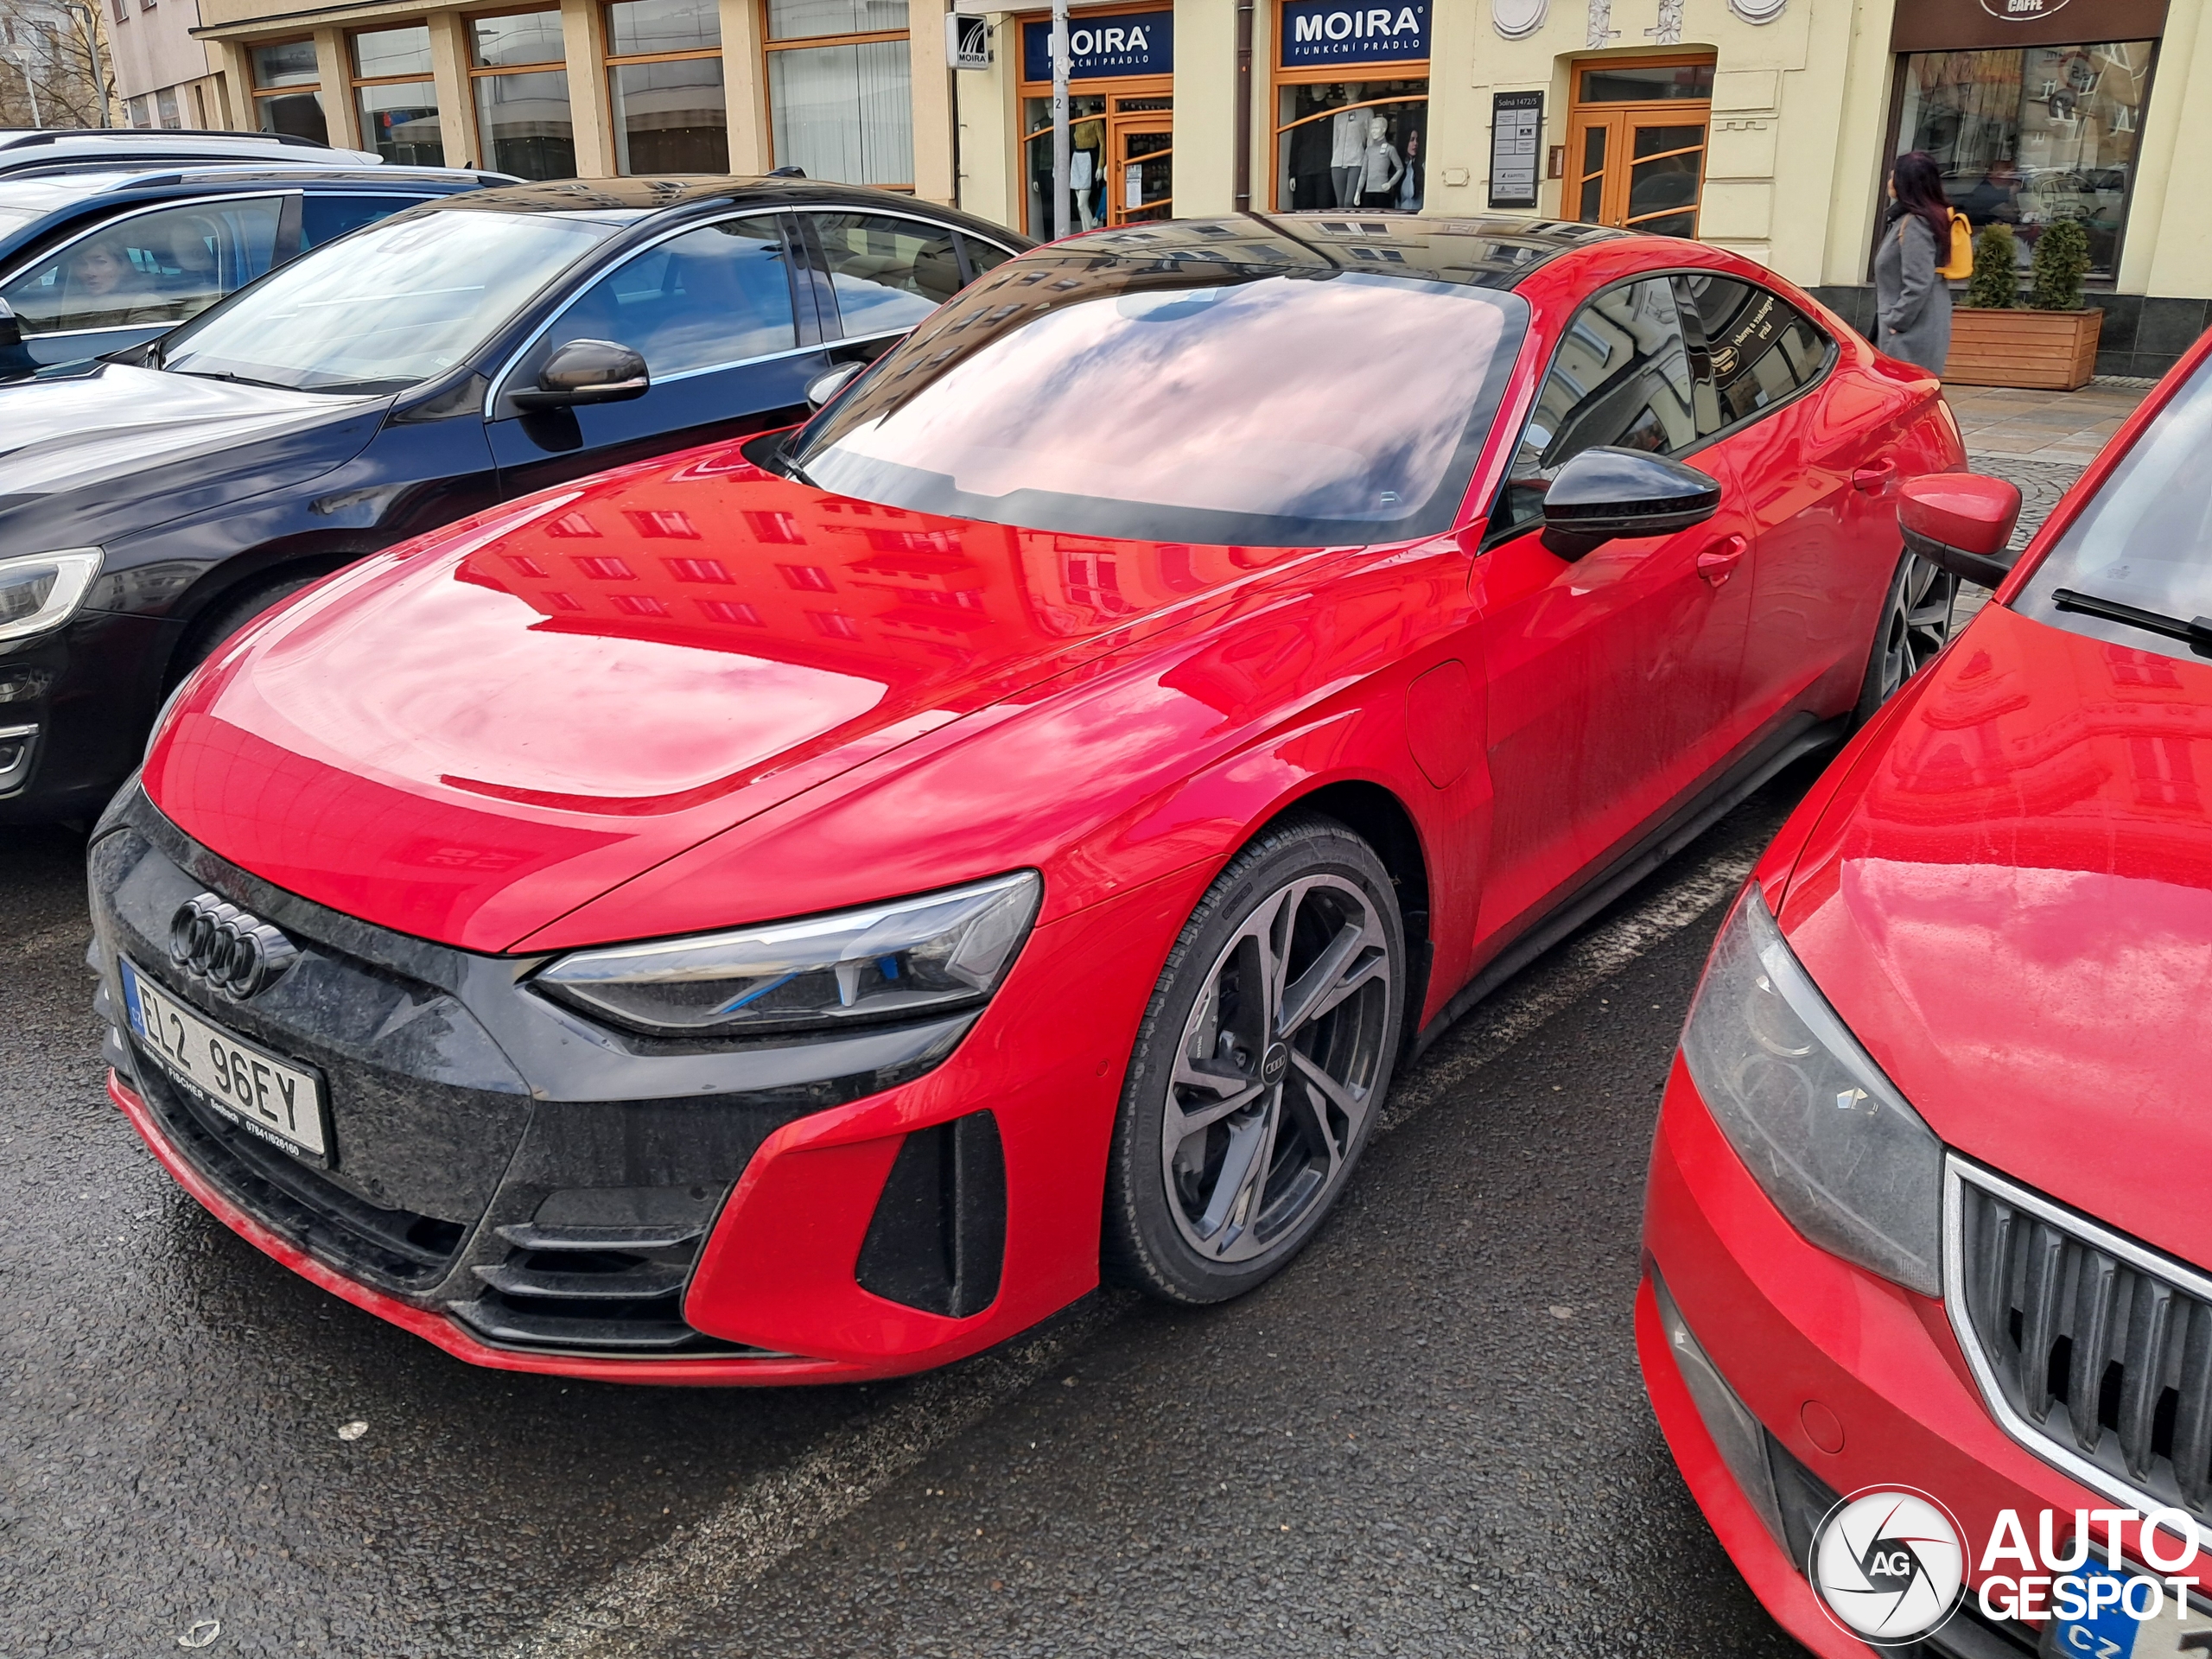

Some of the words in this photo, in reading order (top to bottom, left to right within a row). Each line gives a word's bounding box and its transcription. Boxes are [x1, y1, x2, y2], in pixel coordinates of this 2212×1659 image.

[1047, 26, 1148, 57] OIRA
[1295, 41, 1357, 56] FUNKČNÍ
[1363, 39, 1420, 51] PRÁDLO
[959, 54, 986, 62] MOIRA
[1103, 54, 1149, 66] PRÁDLO
[1055, 98, 1062, 110] 2
[1498, 99, 1516, 107] Solná
[139, 984, 192, 1071] EL2
[209, 1038, 296, 1132] 96EY
[168, 1067, 205, 1101] FISCHER
[2068, 1624, 2122, 1659] CZ
